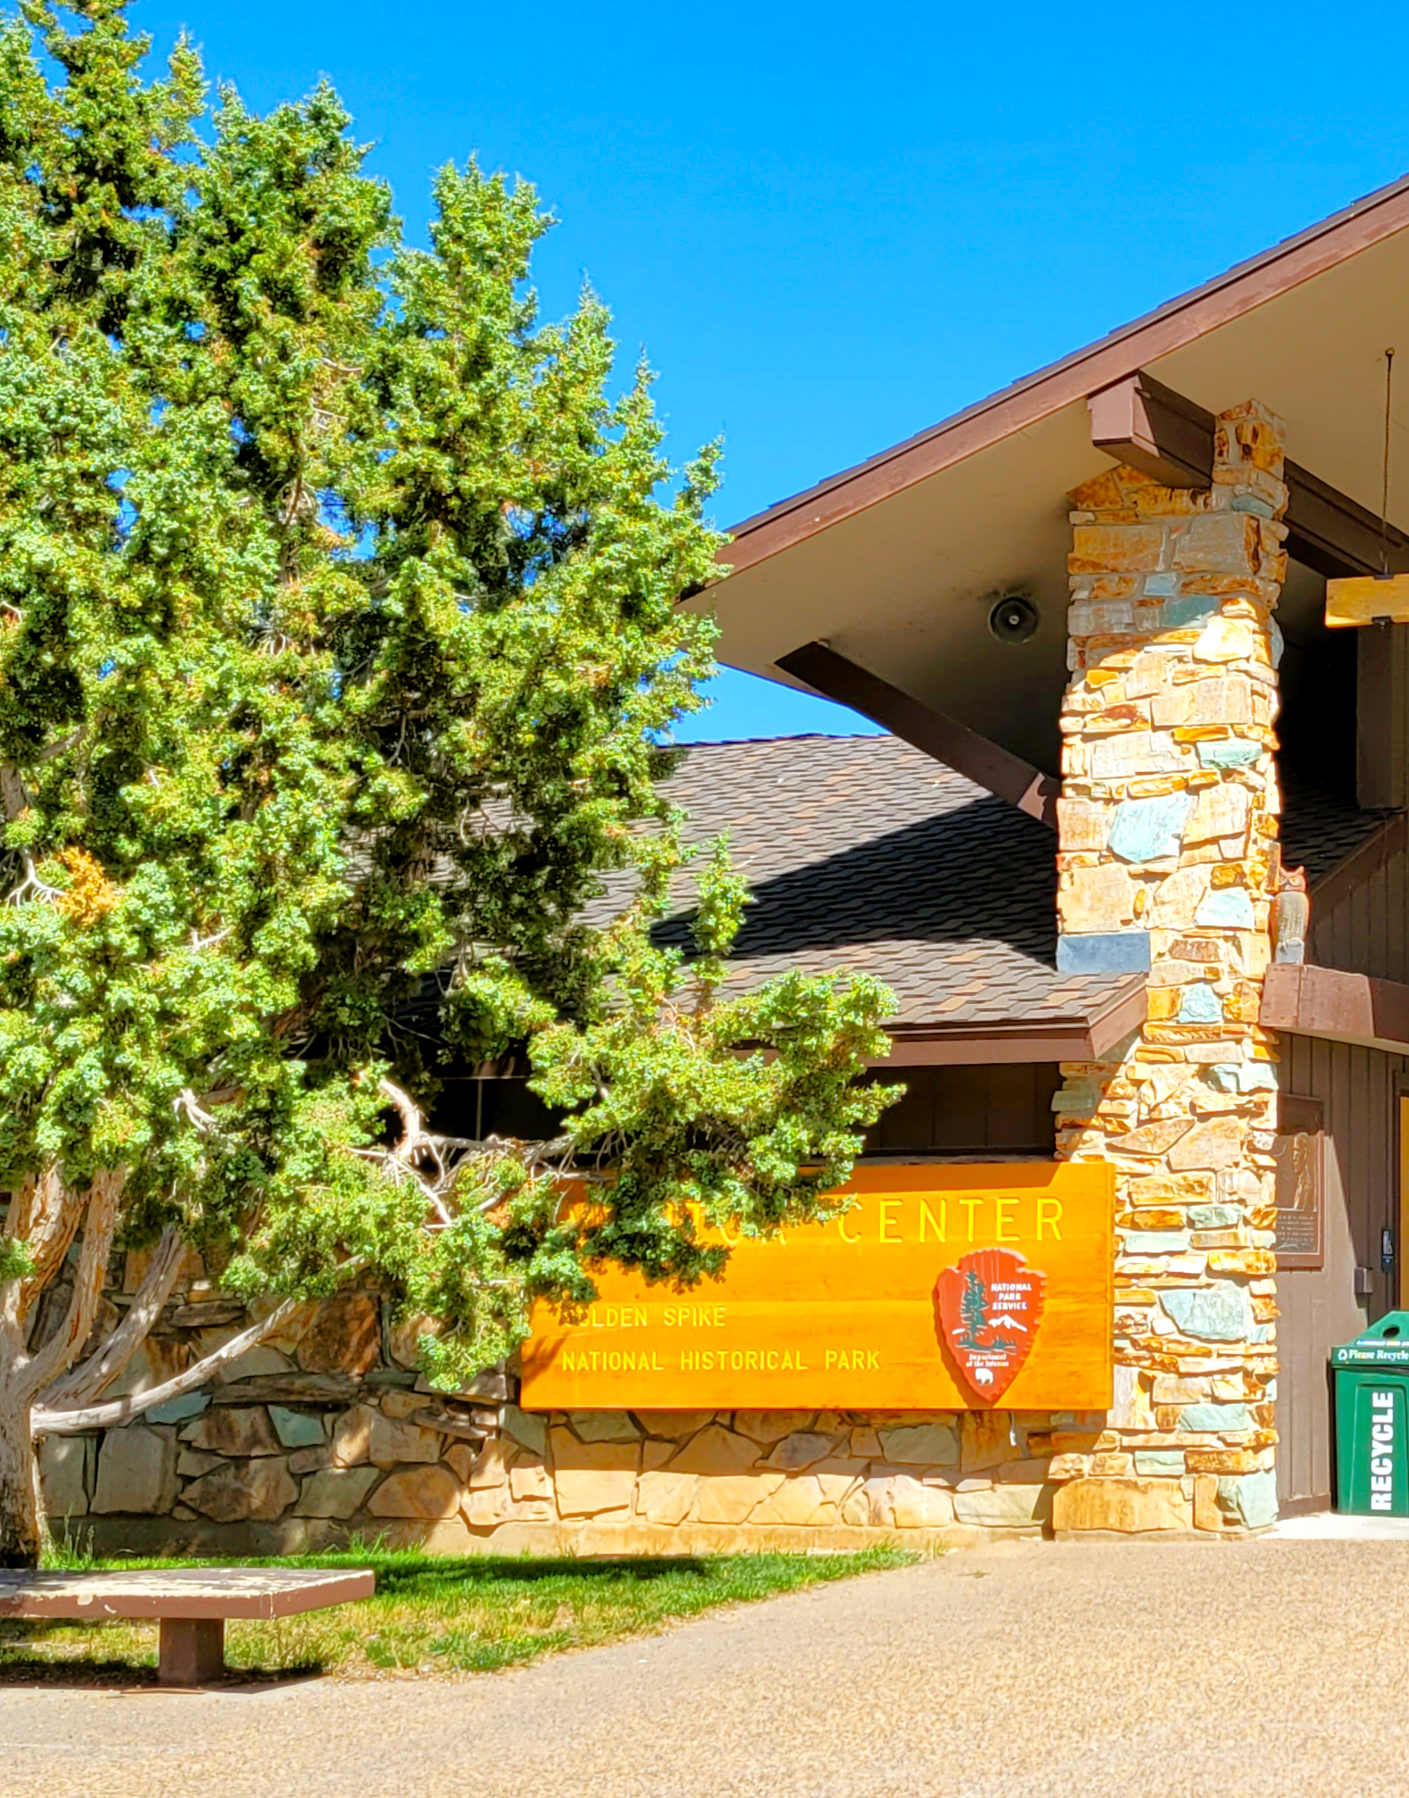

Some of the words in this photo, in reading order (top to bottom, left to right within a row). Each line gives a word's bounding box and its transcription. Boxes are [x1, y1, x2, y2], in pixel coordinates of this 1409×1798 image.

[838, 1196, 1064, 1244] CENTER
[991, 1283, 1032, 1292] NATIONAL
[992, 1301, 1028, 1311] SERVICE
[998, 1293, 1022, 1301] PARK
[663, 1305, 727, 1328] SPIKE
[561, 1350, 665, 1371] NATIONAL
[680, 1349, 809, 1371] HISTORICAL
[824, 1348, 881, 1370] PARK
[1348, 1349, 1375, 1359] Please
[1376, 1349, 1409, 1362] Recycle
[1370, 1392, 1395, 1511] RECYCLE
